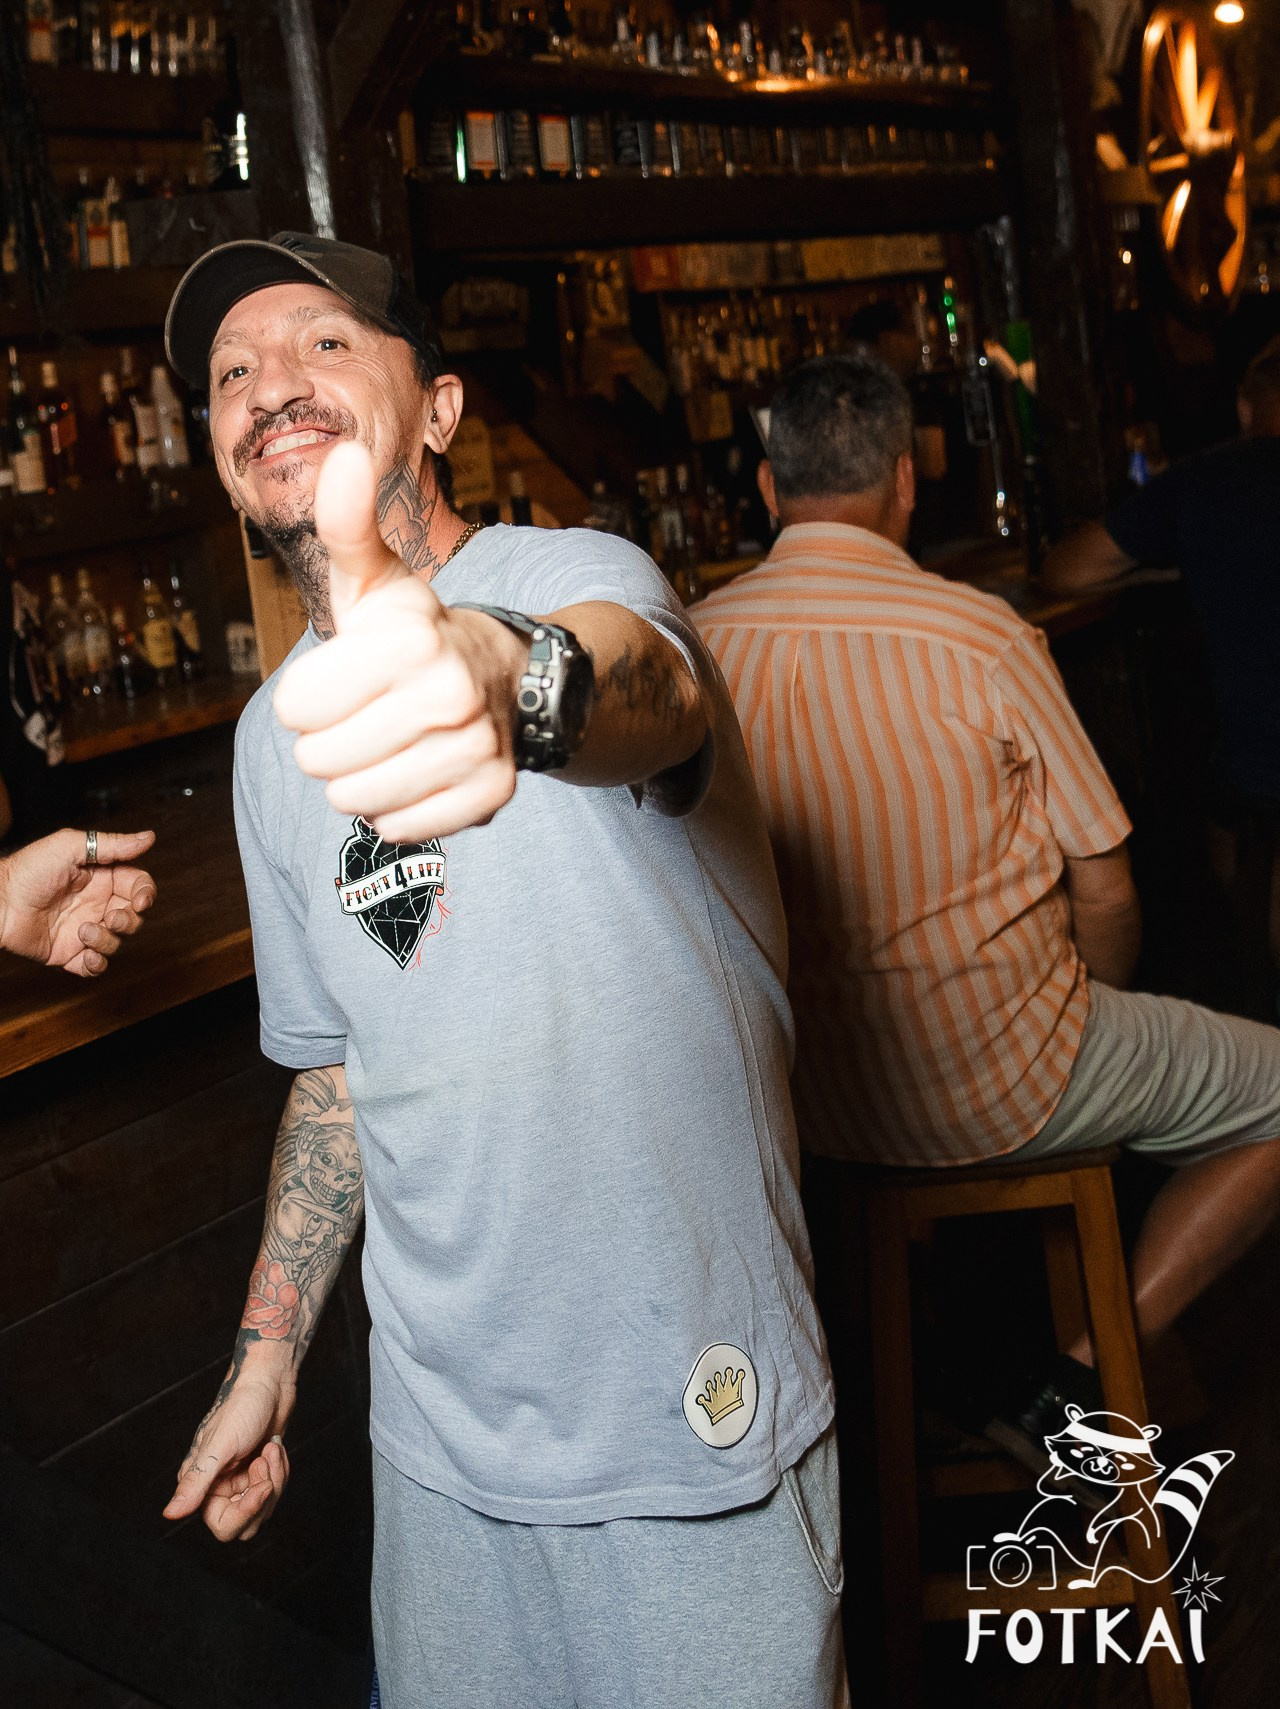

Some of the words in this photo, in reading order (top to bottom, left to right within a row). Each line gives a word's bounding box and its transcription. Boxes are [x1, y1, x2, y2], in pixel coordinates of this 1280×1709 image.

[345, 873, 391, 906] FIGHT
[394, 862, 408, 889] 4
[407, 862, 444, 880] LIFE
